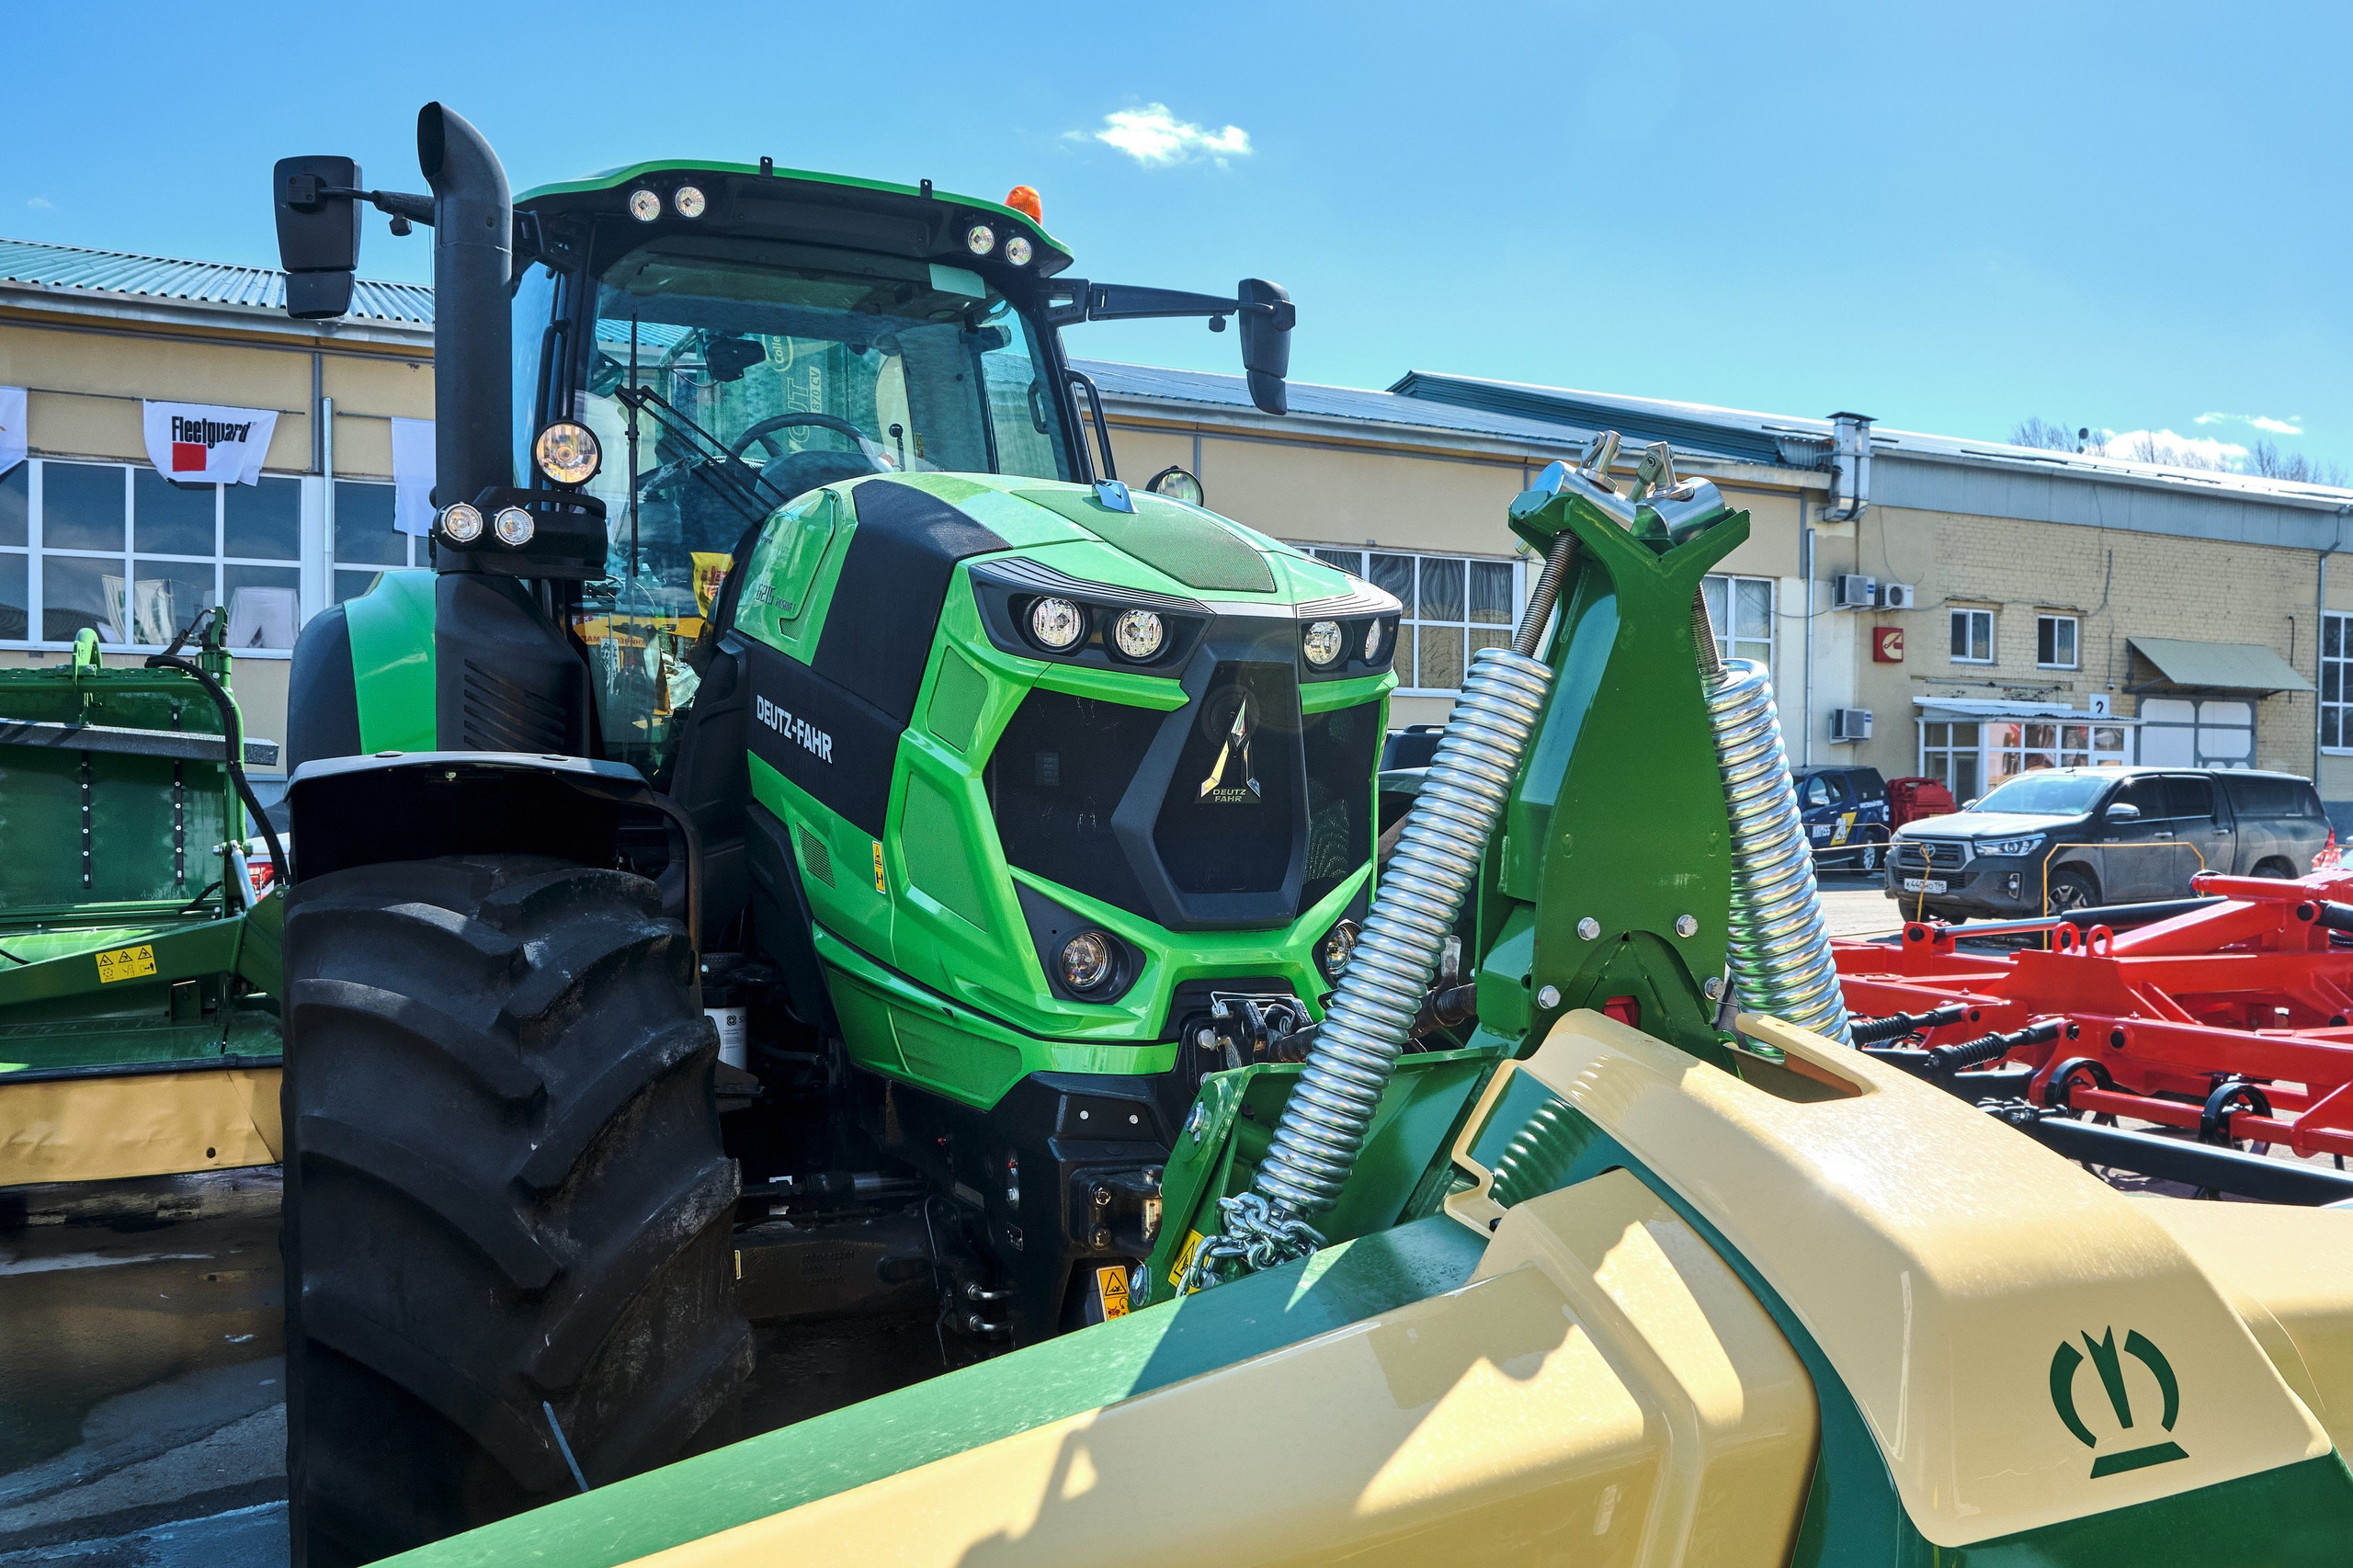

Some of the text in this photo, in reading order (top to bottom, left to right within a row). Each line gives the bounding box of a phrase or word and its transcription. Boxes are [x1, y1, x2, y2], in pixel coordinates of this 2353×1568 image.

[812, 369, 821, 411] 870 CV
[171, 415, 251, 449] Fleetguard
[2096, 700, 2104, 714] 2
[756, 694, 833, 764] DEUTZ-FAHR
